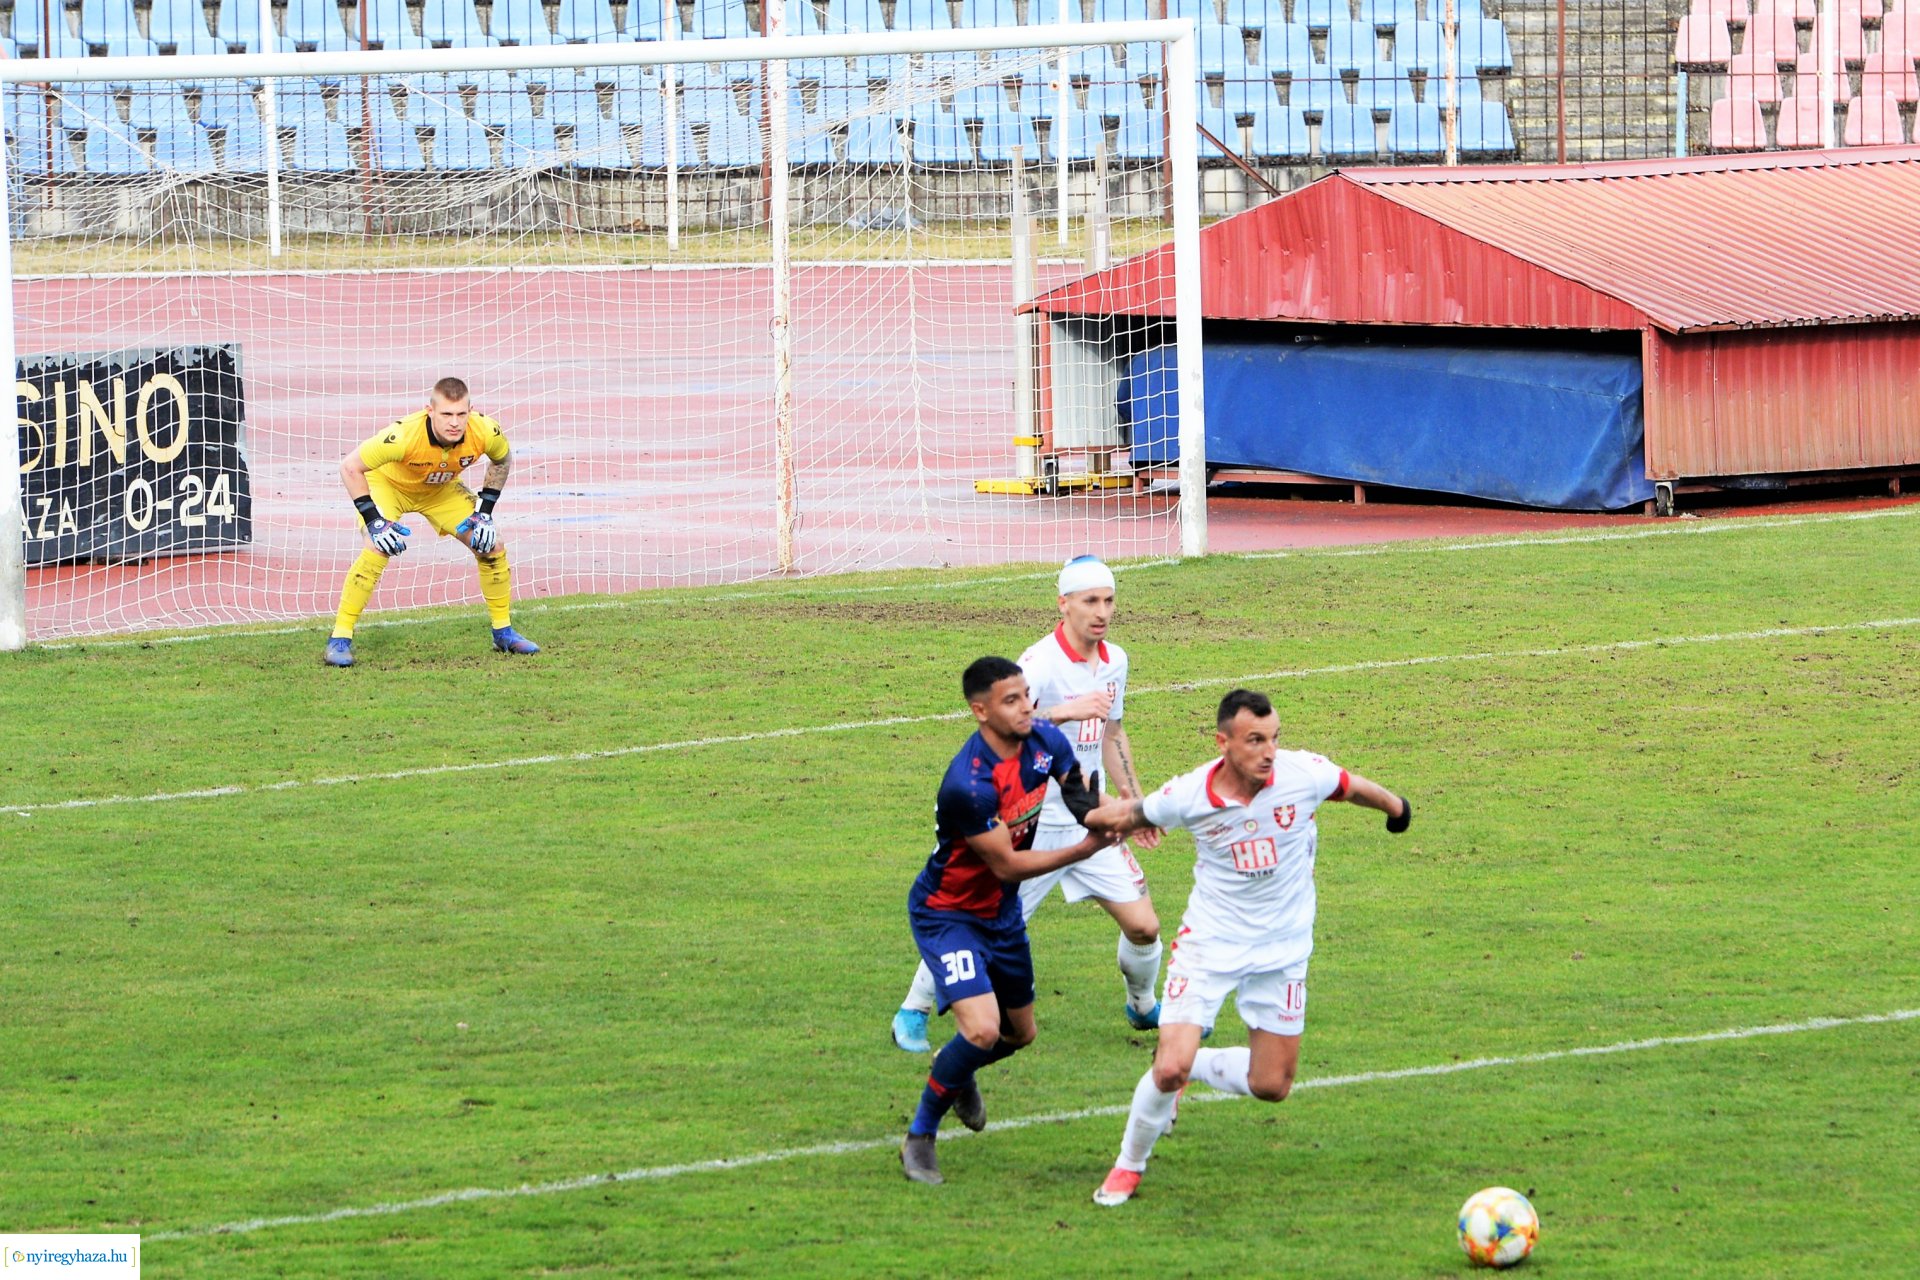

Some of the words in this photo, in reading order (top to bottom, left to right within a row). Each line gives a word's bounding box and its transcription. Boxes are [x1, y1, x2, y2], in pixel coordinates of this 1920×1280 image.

[126, 474, 235, 531] 0-24
[1232, 837, 1277, 869] HR
[941, 949, 976, 986] 30
[1287, 982, 1301, 1010] 10
